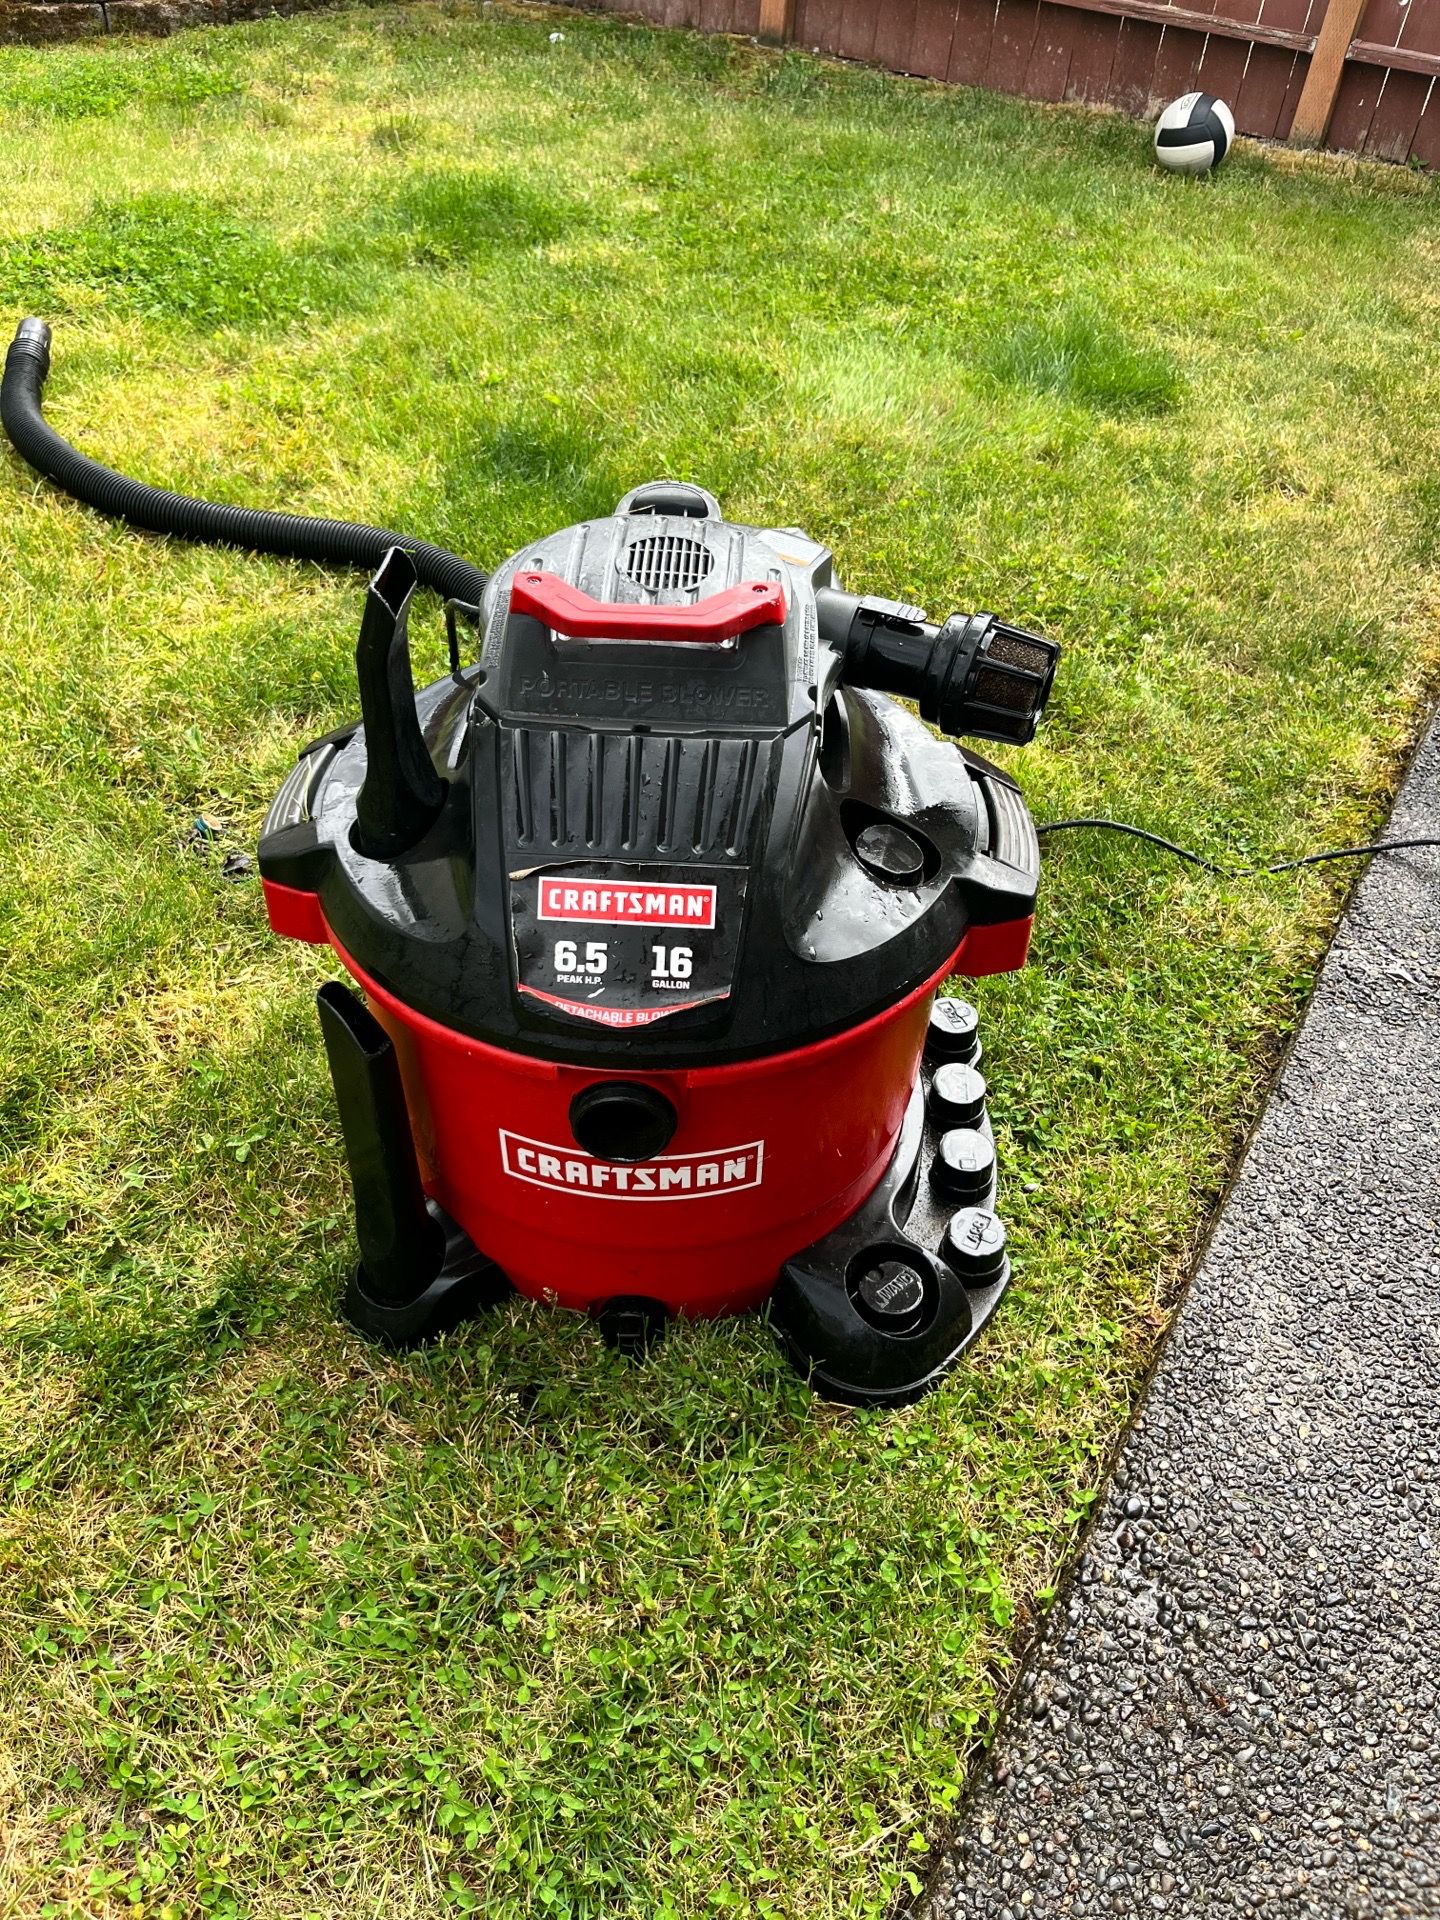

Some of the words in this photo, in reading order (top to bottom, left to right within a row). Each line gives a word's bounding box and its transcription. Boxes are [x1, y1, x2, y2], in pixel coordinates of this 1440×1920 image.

[519, 676, 653, 703] PORTABLE
[661, 682, 769, 708] BLOWER
[549, 888, 703, 917] CRAFTSMAN
[554, 940, 608, 974] 6.5
[651, 945, 693, 979] 16
[557, 974, 583, 984] PEAK
[584, 975, 603, 985] H.P.
[652, 979, 691, 990] GALLON
[517, 1148, 748, 1190] CRAFTSMAN
